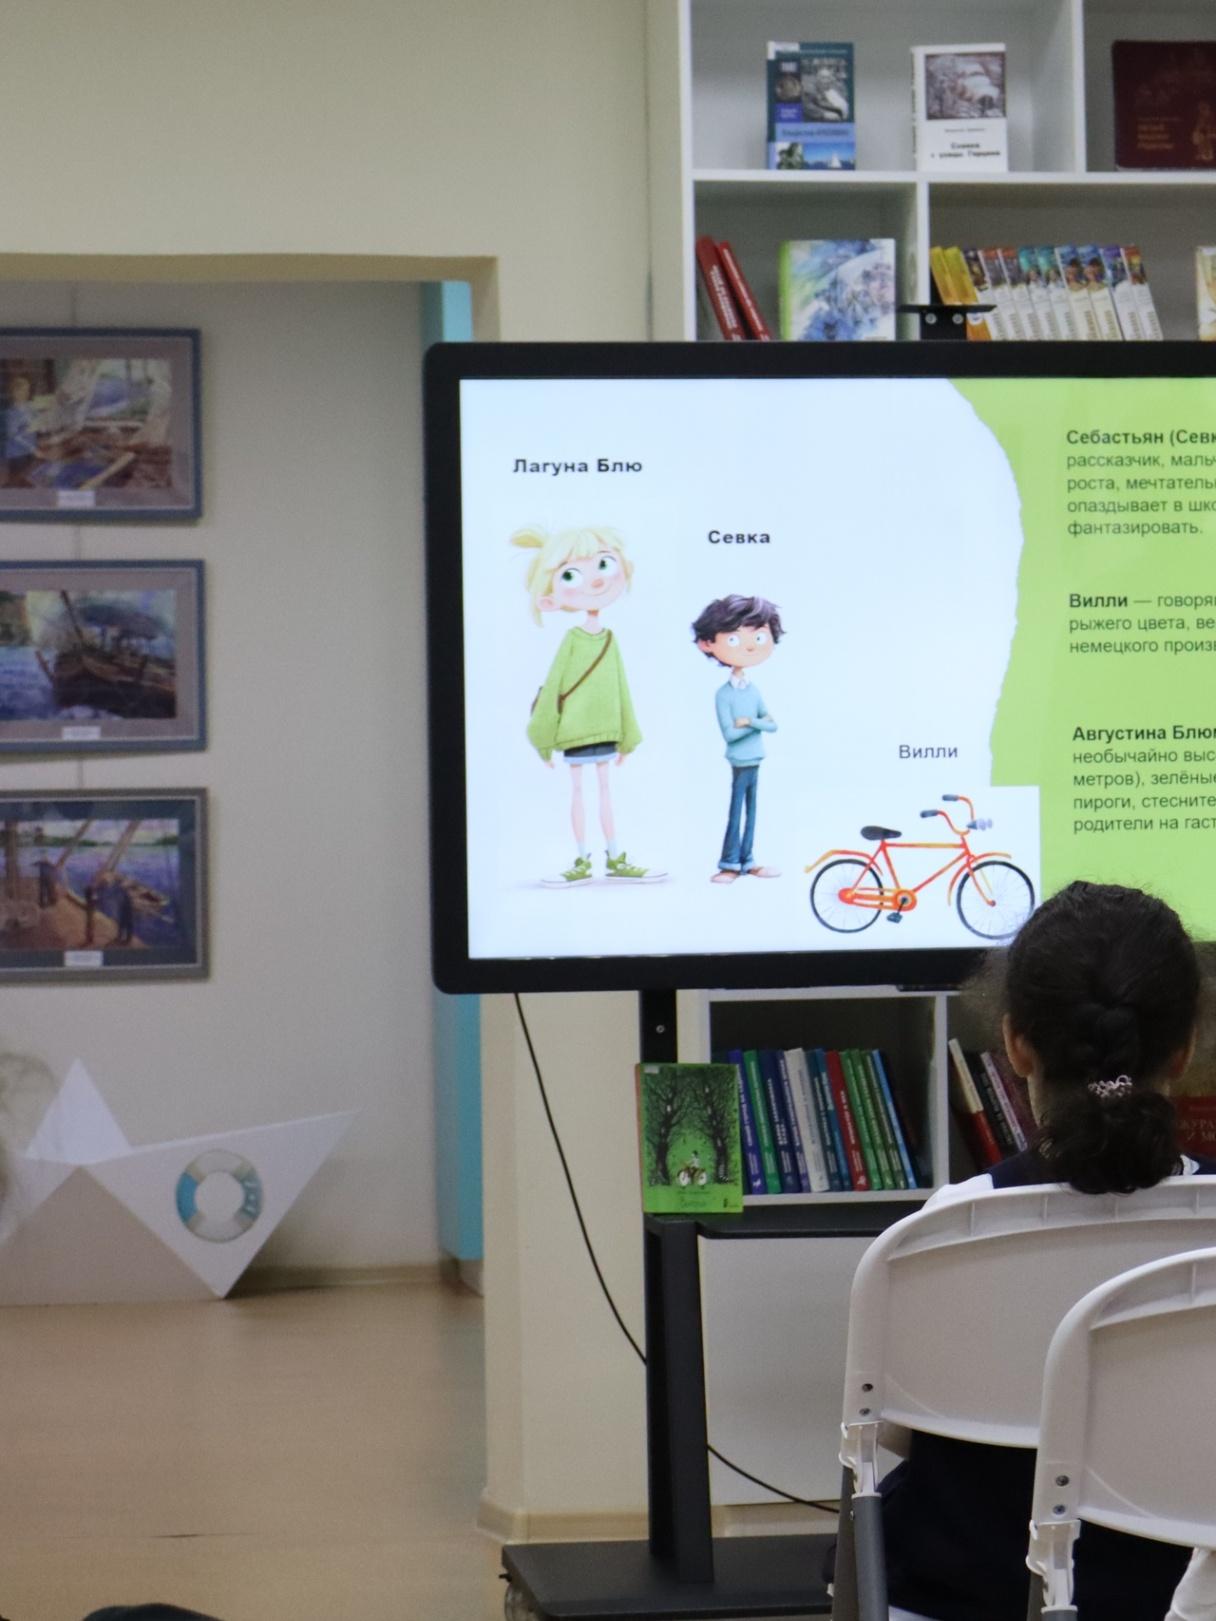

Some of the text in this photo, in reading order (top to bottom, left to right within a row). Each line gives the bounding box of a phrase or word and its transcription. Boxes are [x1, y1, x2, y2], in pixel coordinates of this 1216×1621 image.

[1065, 429, 1164, 445] Себастьян
[512, 458, 643, 477] Лагуна Блю
[1066, 455, 1165, 471] рассказчик,
[1066, 478, 1121, 494] роста,
[1066, 500, 1169, 515] опаздывает
[1173, 500, 1184, 513] в
[707, 529, 771, 545] Севка
[1066, 519, 1203, 539] фантазировать.
[1069, 593, 1129, 609] Вилли
[1068, 618, 1133, 635] рыжего
[1137, 617, 1190, 633] цвета,
[1069, 640, 1159, 655] немецкого
[1072, 726, 1167, 745] Августина
[898, 744, 958, 760] Вилли
[1072, 747, 1179, 764] необычайно
[1073, 770, 1145, 790] метров),
[1073, 796, 1136, 813] пироги,
[1073, 818, 1154, 835] родители
[1159, 817, 1180, 830] на
